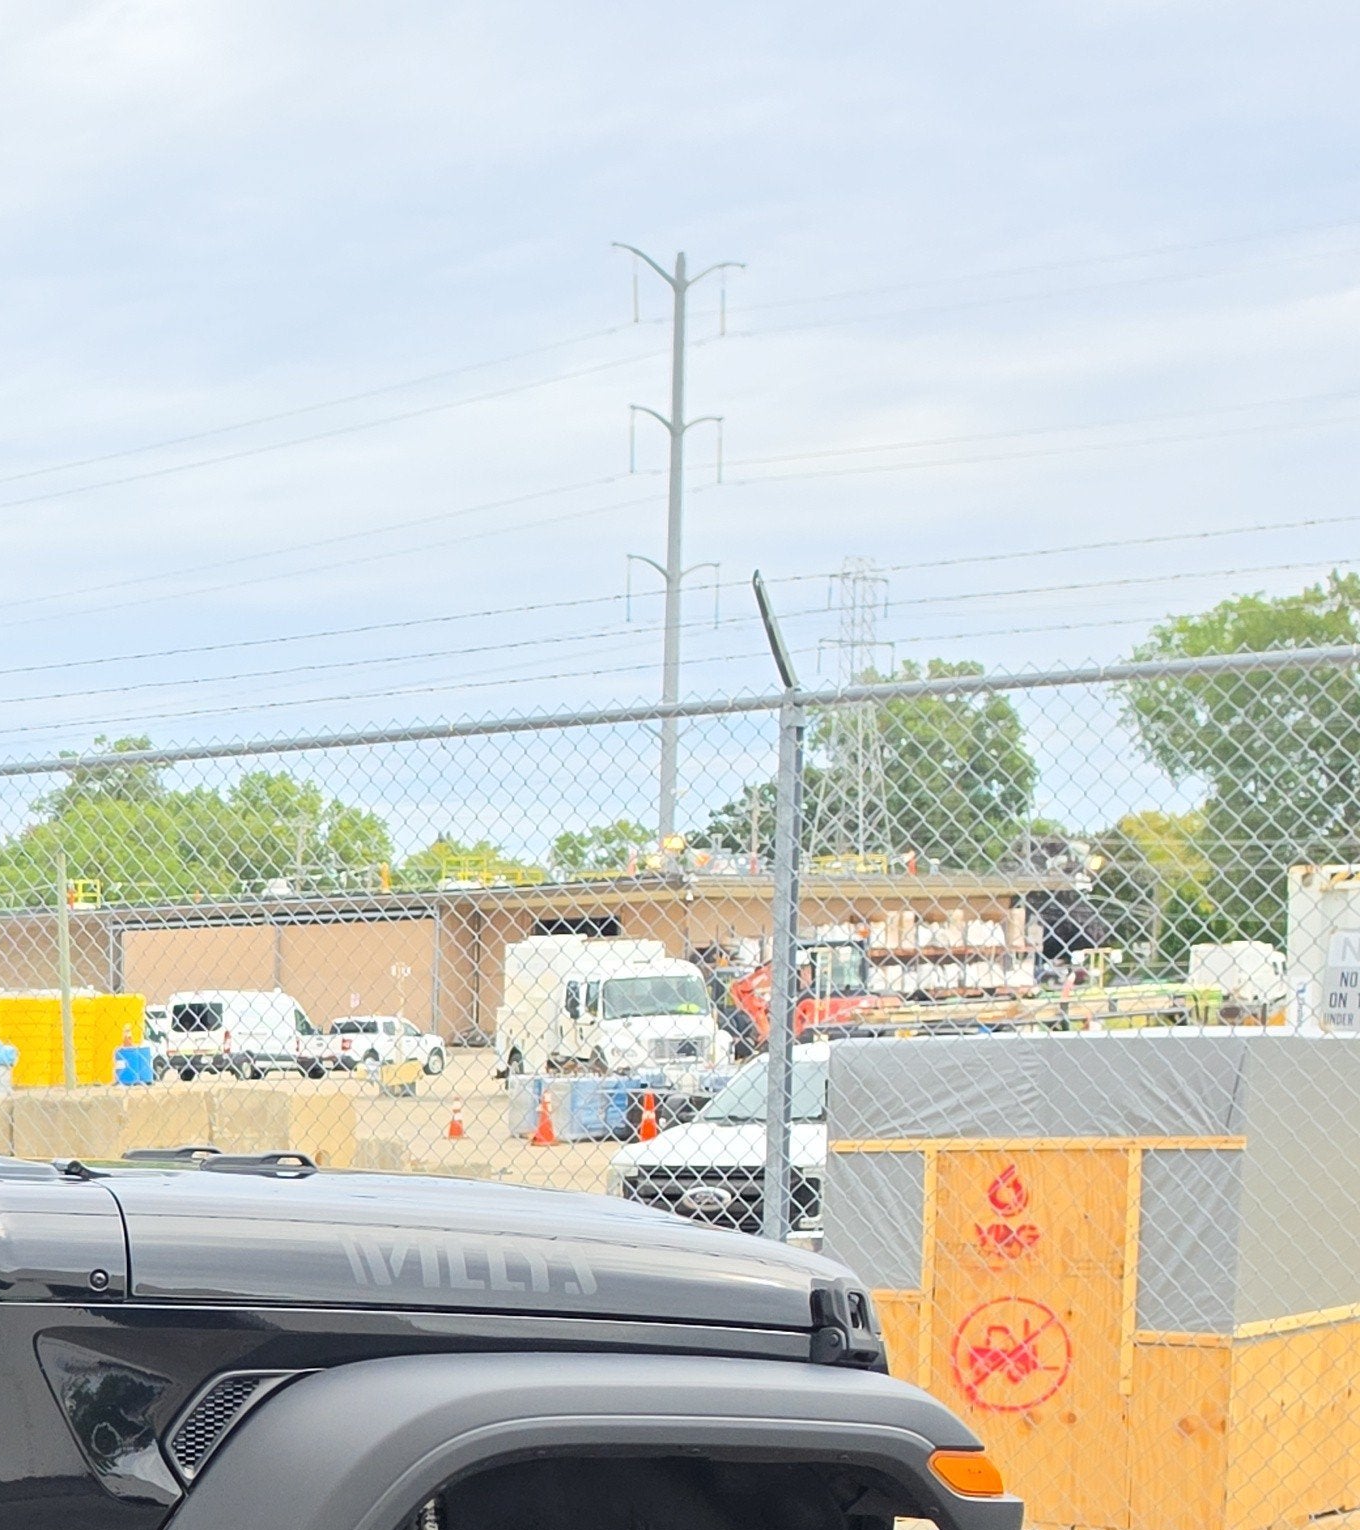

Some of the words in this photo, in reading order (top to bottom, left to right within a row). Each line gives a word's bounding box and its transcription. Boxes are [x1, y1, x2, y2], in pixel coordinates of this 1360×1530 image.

[1329, 992, 1347, 1008] ON
[1323, 1012, 1354, 1026] UNDER
[340, 1235, 597, 1295] WILLYS
